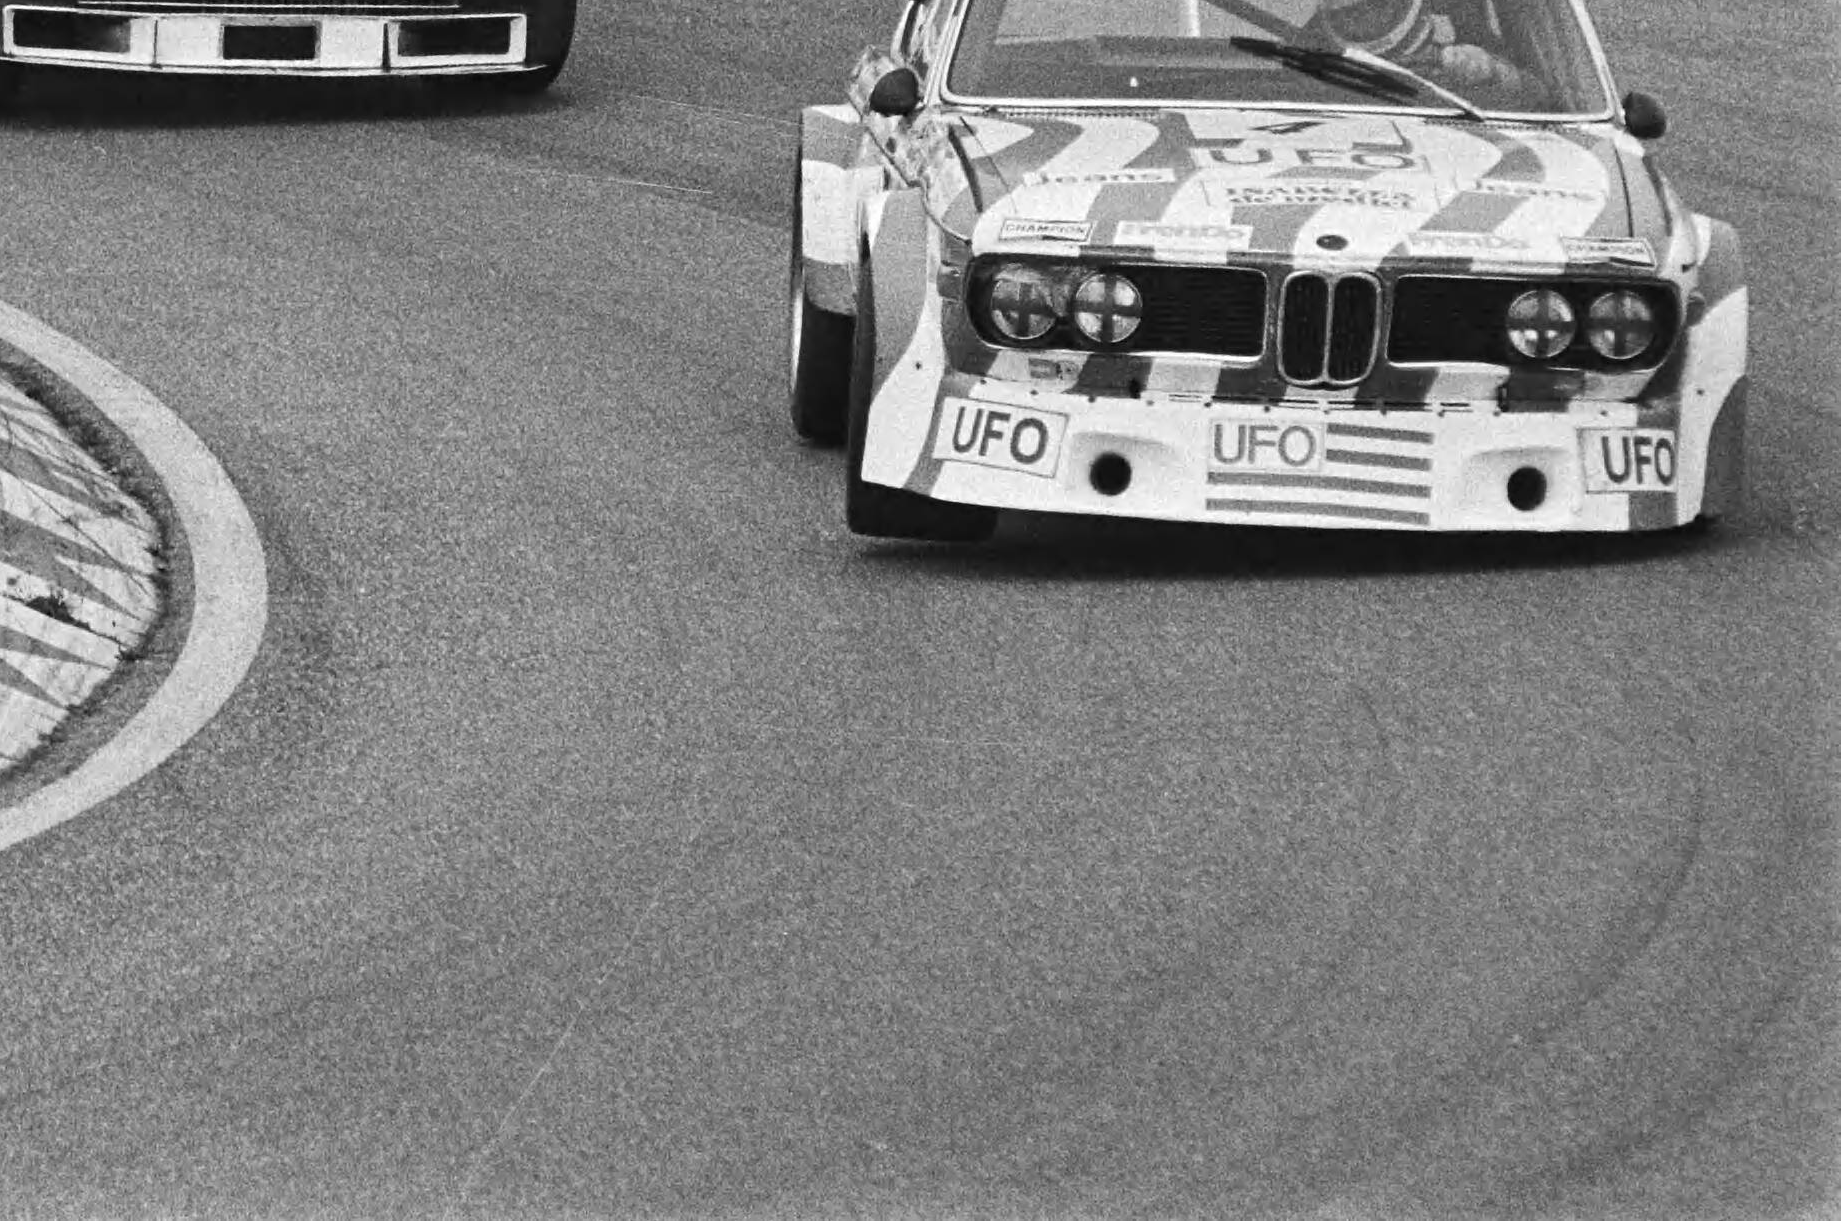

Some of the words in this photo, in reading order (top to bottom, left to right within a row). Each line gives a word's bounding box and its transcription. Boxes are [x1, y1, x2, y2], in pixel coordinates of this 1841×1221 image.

[1209, 147, 1417, 170] UFO
[952, 405, 1050, 465] UFO
[1213, 423, 1317, 467] UFO
[1601, 435, 1676, 486] UFO
